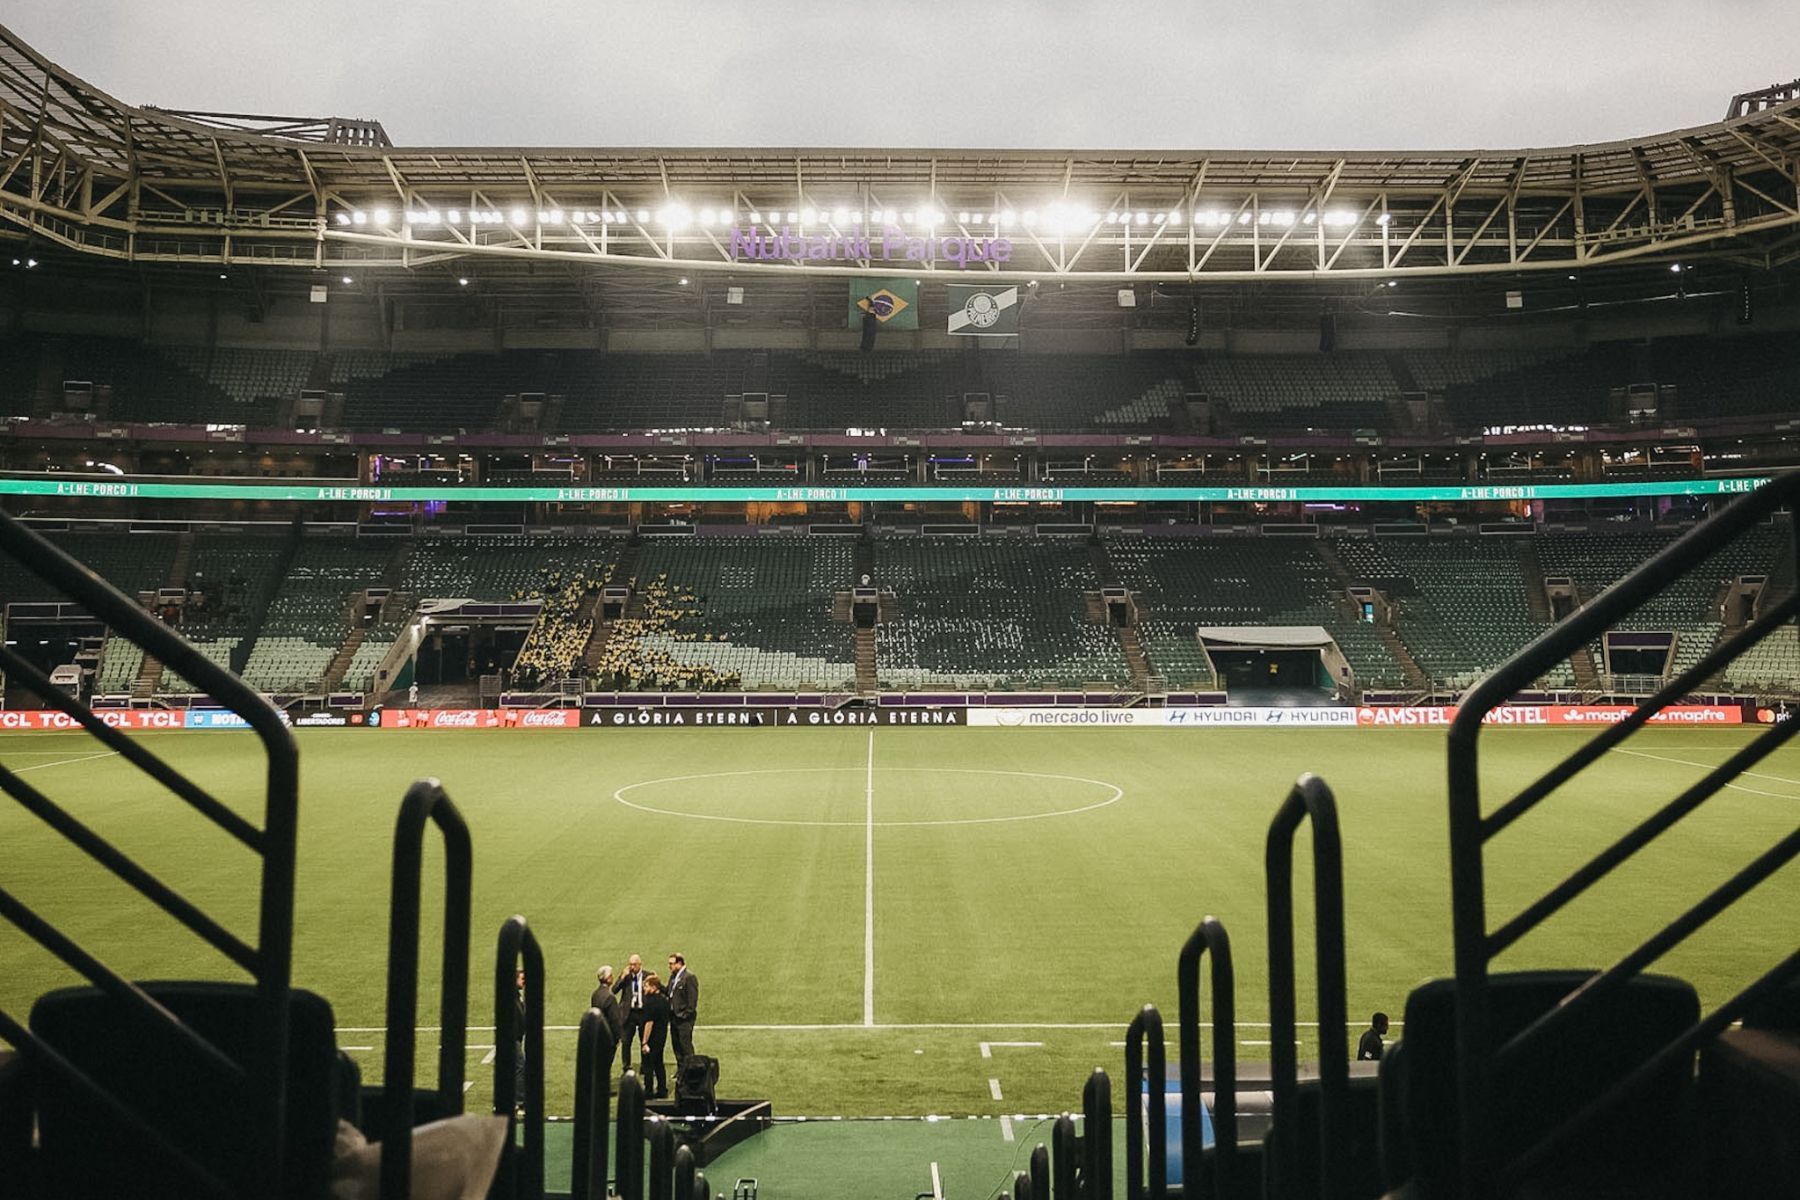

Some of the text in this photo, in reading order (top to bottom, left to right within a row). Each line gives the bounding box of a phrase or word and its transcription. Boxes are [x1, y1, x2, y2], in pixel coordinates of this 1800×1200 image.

[730, 226, 1013, 268] Nubank Parque
[93, 484, 127, 496] PORCO
[350, 489, 381, 499] PORCO
[589, 488, 618, 499] PORCO
[807, 488, 837, 499] PORCO
[1024, 489, 1054, 500] PORCO
[1257, 488, 1287, 499] PORCO
[1492, 487, 1524, 498] PORCO
[0, 713, 31, 727] CL
[94, 713, 131, 727] CL
[138, 713, 181, 727] TCL
[591, 712, 602, 724] A
[613, 710, 684, 724] GLÓRIA
[787, 710, 957, 724] A GLÓRIA ETERNA
[1029, 710, 1134, 723] mercado livre
[1194, 711, 1257, 722] HYUNDAI
[1291, 711, 1354, 721] HYUNDAI
[1374, 708, 1450, 724] AMSTEL
[1586, 709, 1632, 723] mapf
[1668, 709, 1725, 722] mapfre
